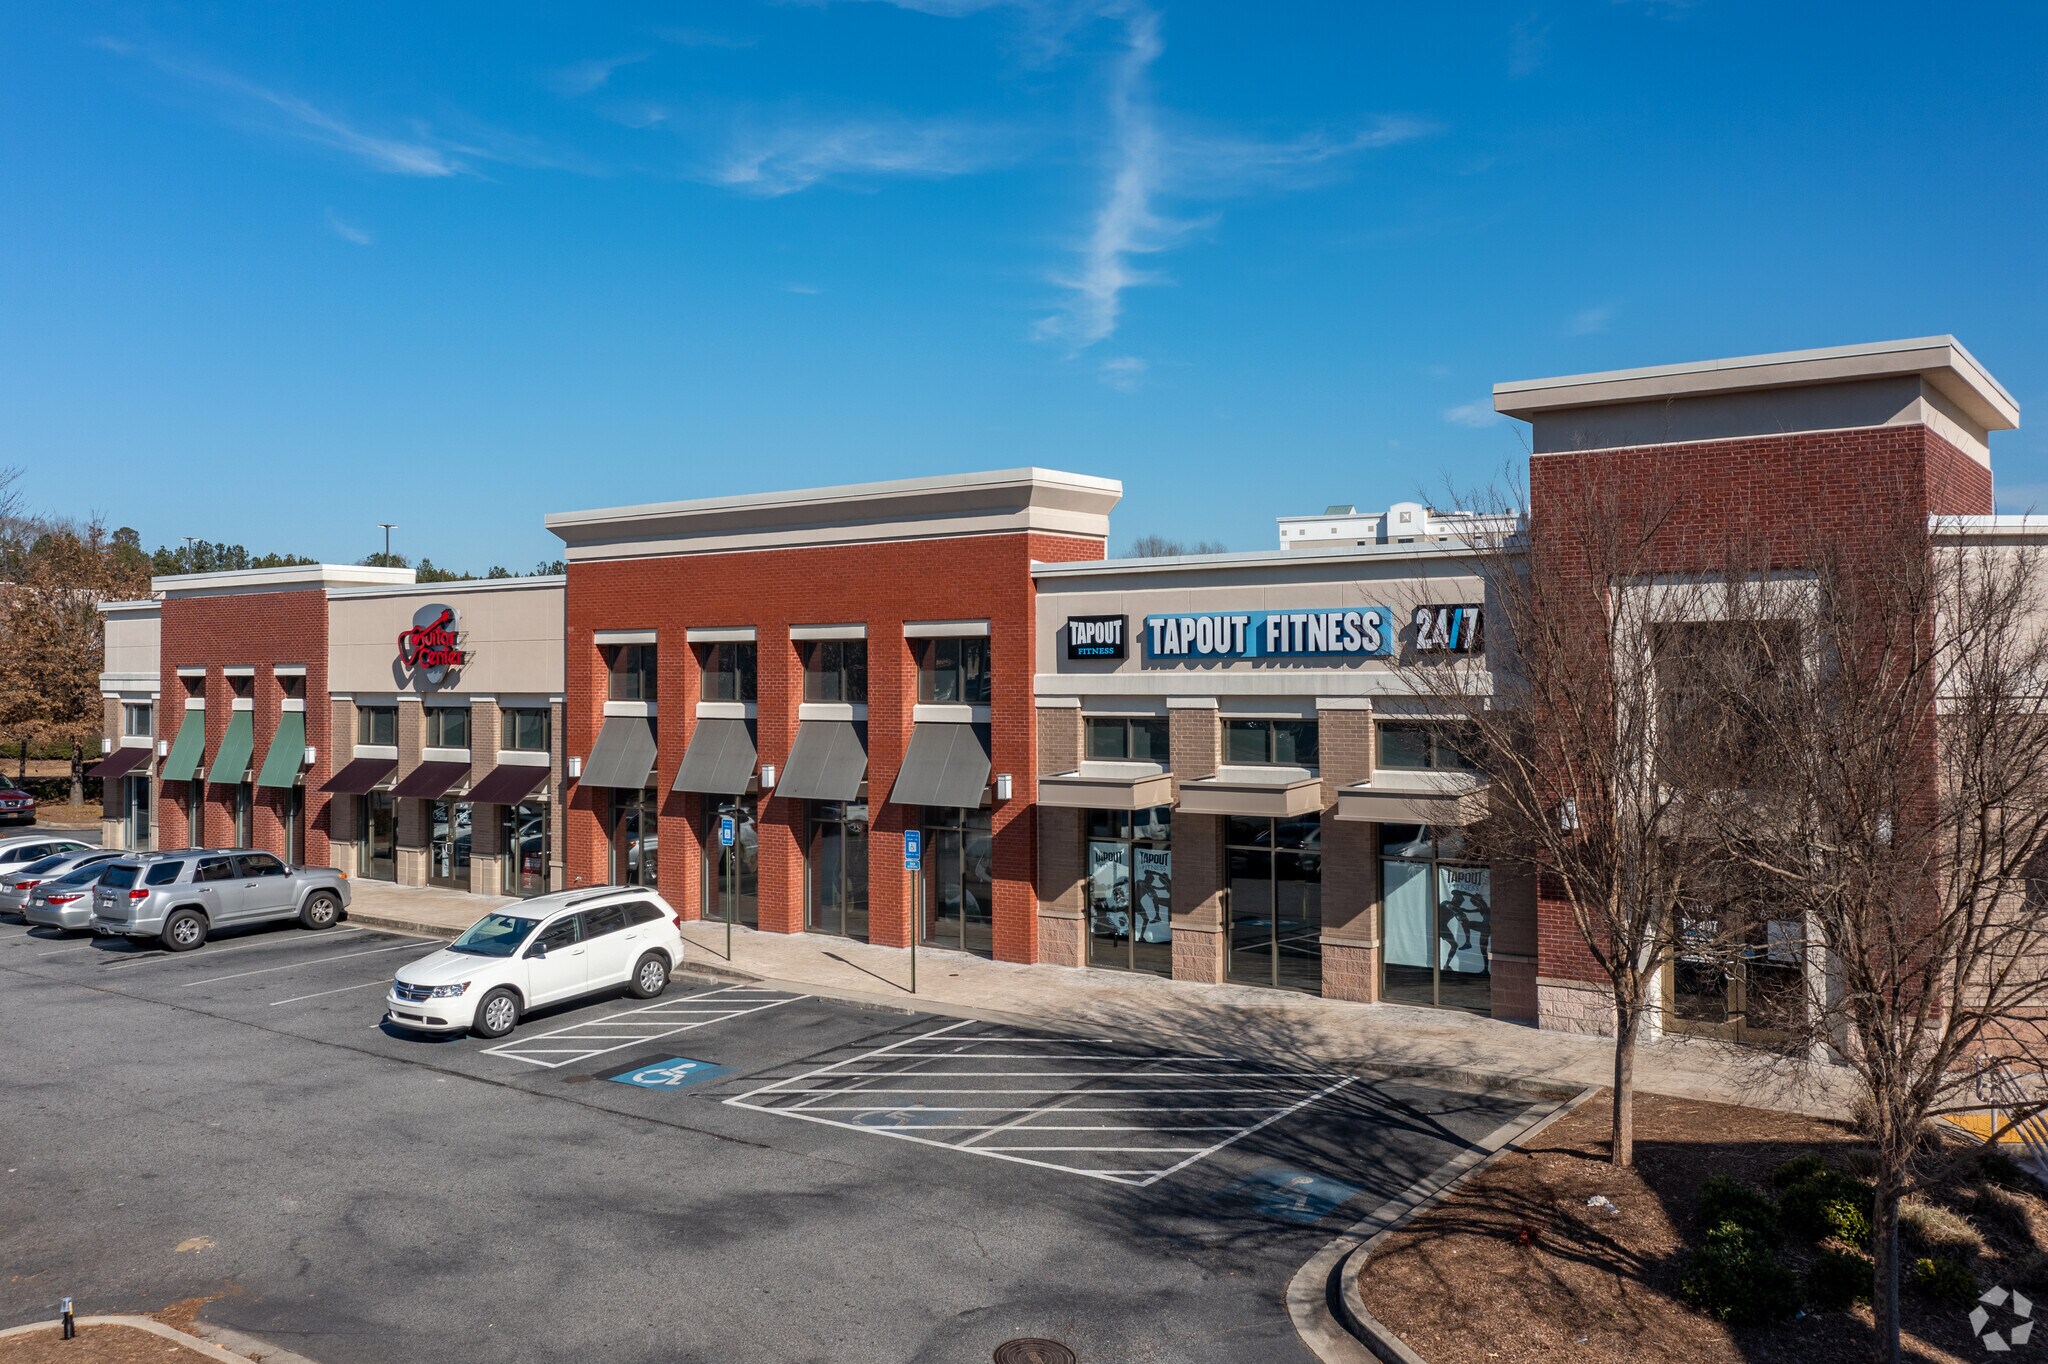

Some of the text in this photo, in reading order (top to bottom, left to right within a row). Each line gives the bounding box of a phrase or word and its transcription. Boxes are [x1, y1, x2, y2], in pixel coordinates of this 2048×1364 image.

[1070, 620, 1122, 646] TAPOUT
[1149, 611, 1381, 654] TAPOUT FITNESS
[1416, 608, 1478, 649] 24/7
[419, 646, 462, 668] Center
[1078, 647, 1114, 655] FITNESS
[1140, 851, 1169, 866] TAPOUT
[1447, 869, 1482, 886] TAPOUT
